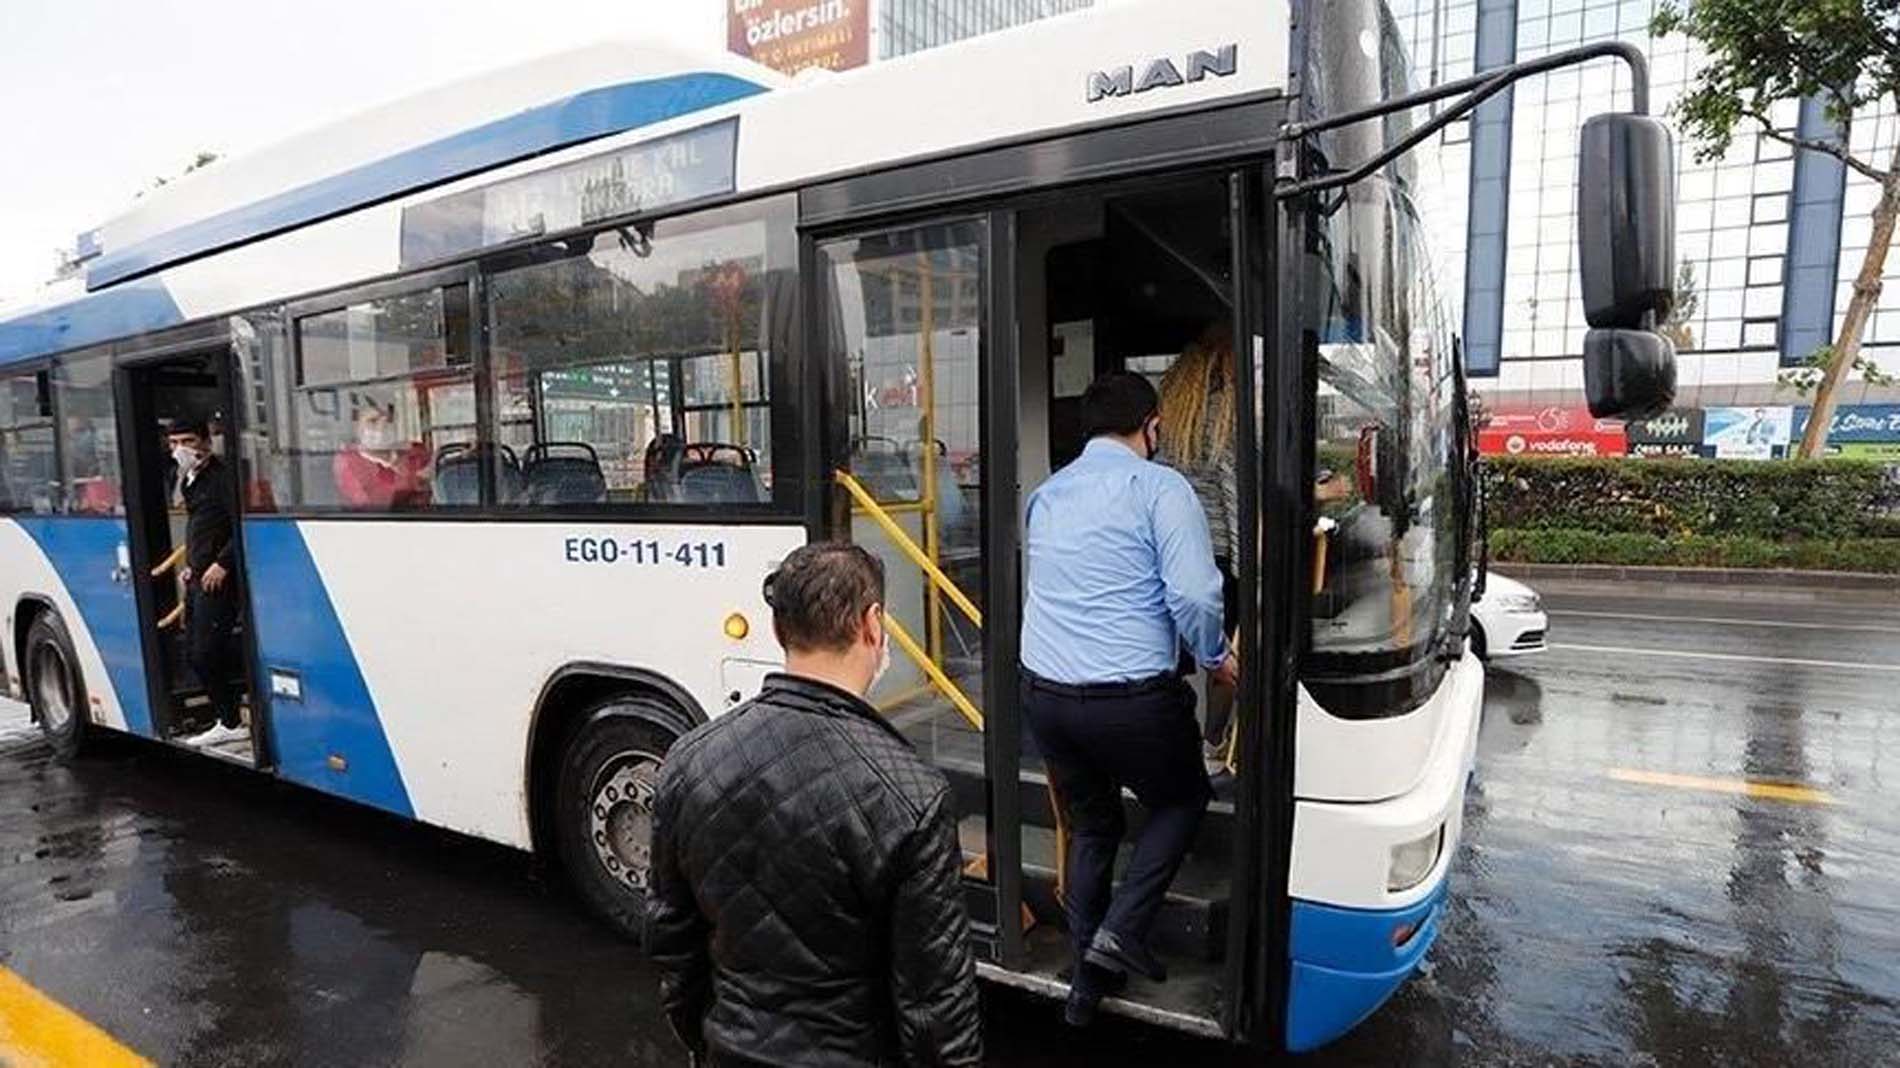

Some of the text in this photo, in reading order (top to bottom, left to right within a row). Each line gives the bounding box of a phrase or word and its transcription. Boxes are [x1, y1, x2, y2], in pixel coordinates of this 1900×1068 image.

[1087, 43, 1237, 103] MAN
[1529, 439, 1596, 452] vodafone
[565, 538, 725, 567] EGO-11-411
